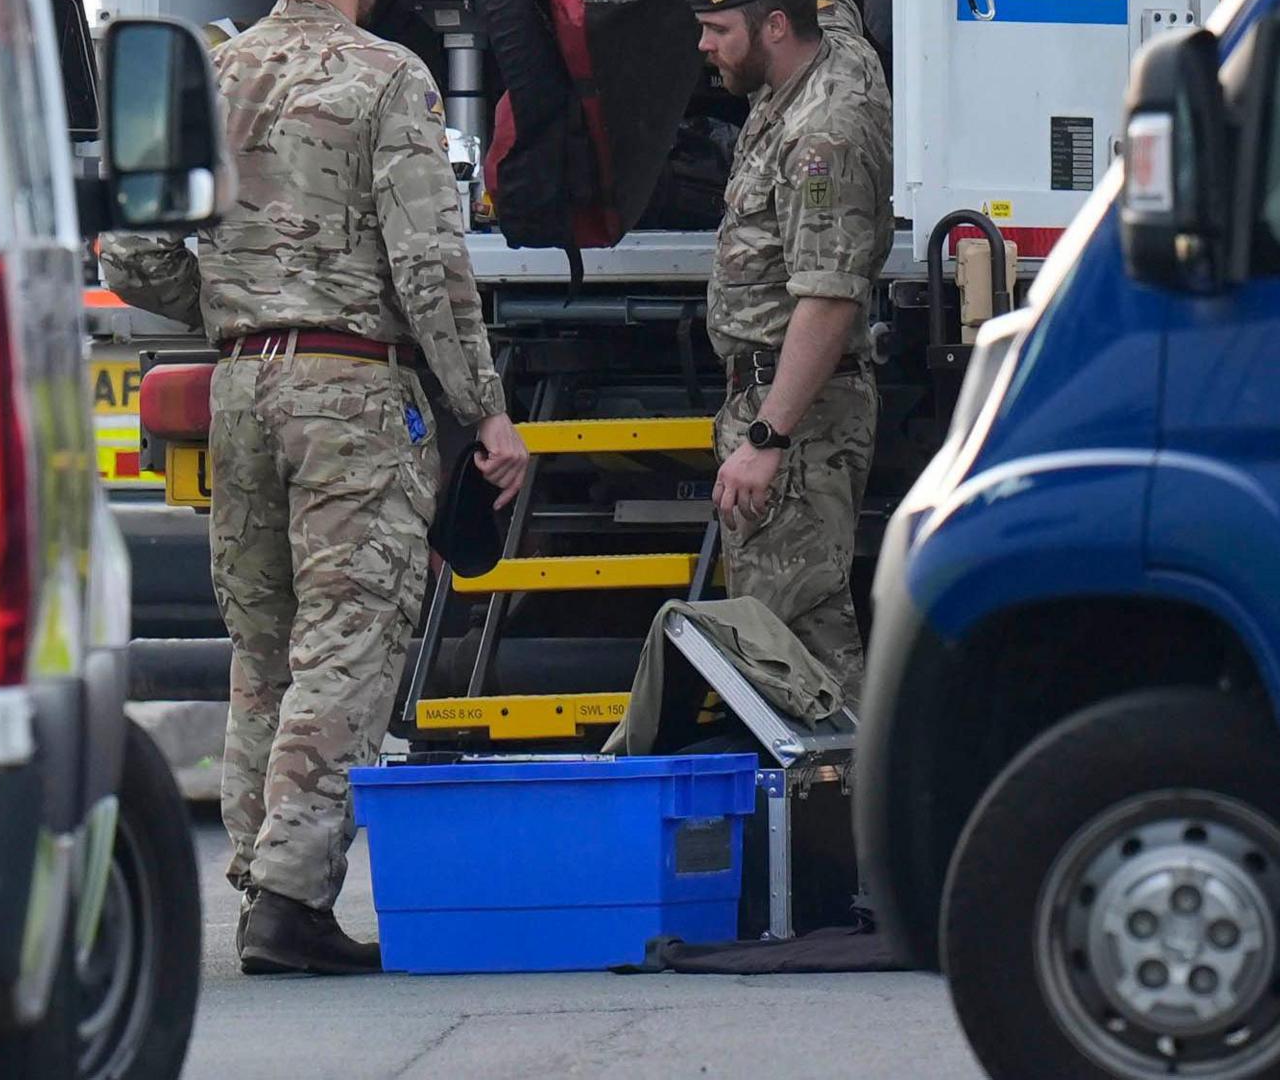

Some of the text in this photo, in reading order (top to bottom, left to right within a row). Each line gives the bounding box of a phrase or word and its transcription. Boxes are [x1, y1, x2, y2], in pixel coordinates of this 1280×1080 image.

[426, 709, 456, 720] MASS
[468, 708, 482, 719] KG
[580, 704, 604, 716] SWL
